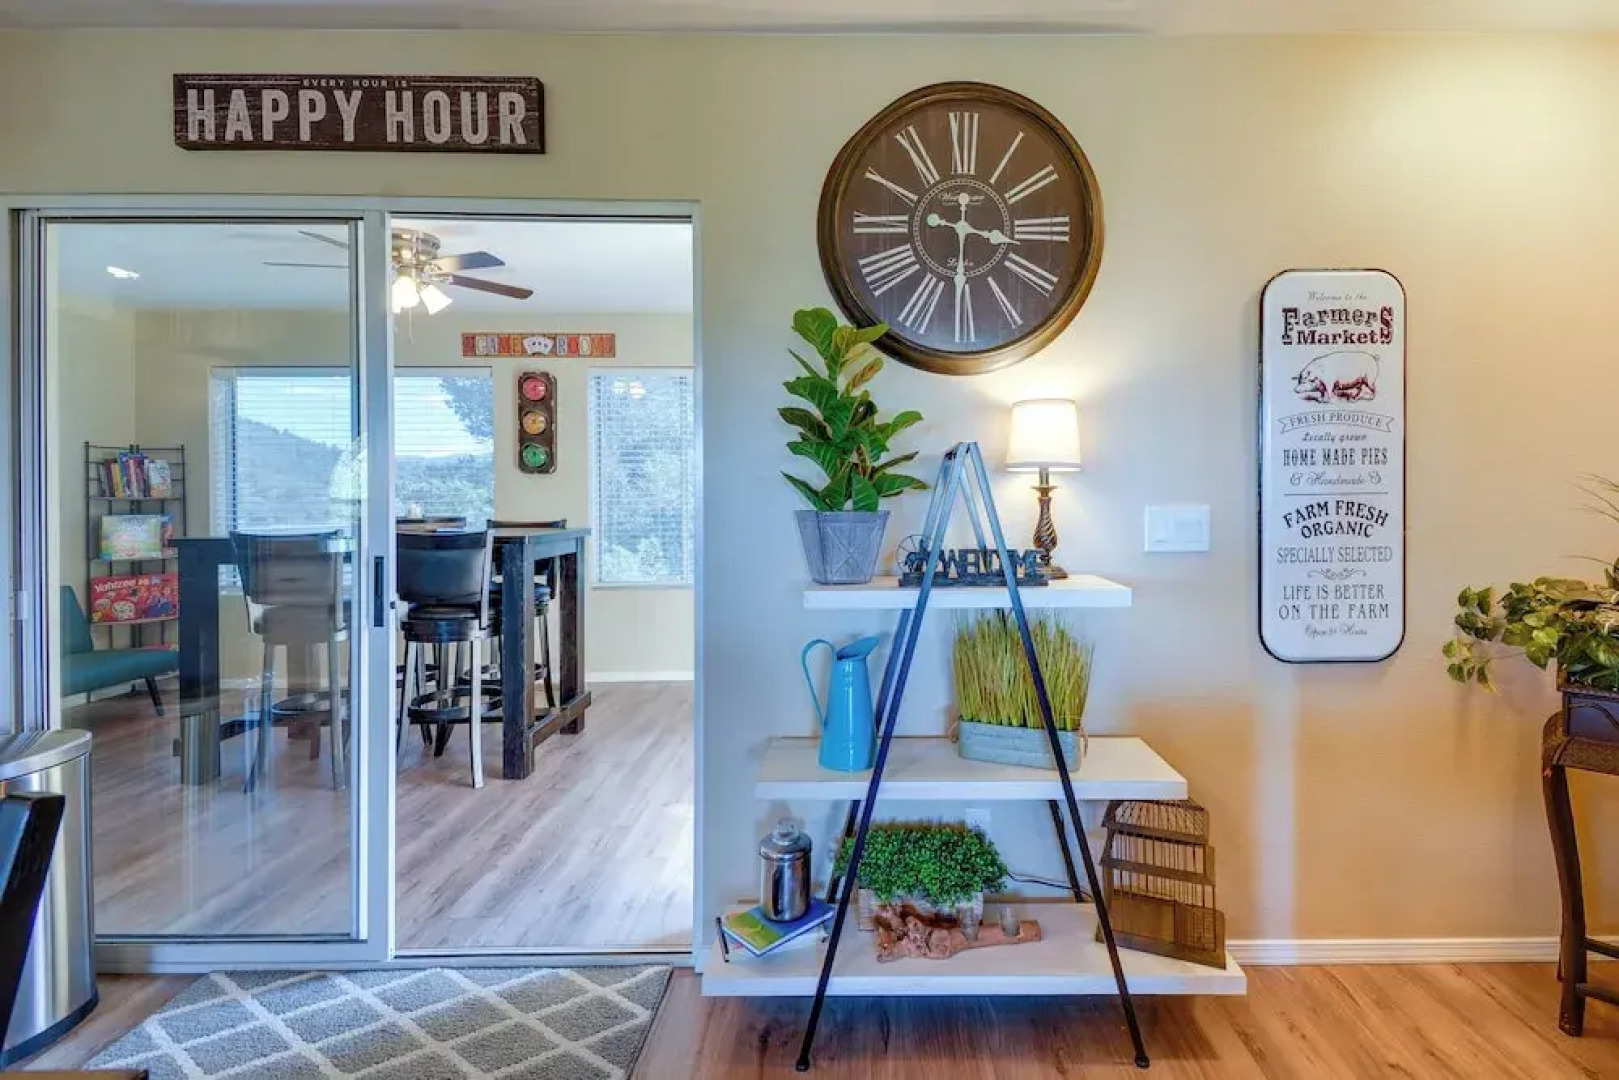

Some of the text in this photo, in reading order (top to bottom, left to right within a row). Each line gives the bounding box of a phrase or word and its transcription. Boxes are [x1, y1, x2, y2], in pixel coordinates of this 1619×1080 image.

[302, 79, 407, 88] EVERY HOUR IS
[186, 88, 527, 145] HAPPY HOUR
[949, 112, 979, 175] XII
[1297, 329, 1379, 345] Market
[1290, 412, 1382, 427] FRESH PRODUCE
[1302, 431, 1367, 443] Locally grown
[1283, 446, 1388, 467] HOME MADE PIES
[1282, 500, 1389, 529] FARM FRESH
[1301, 520, 1375, 539] ORGANIC
[1276, 545, 1393, 564] SPECIALLY SELECTED
[1283, 584, 1385, 600] LIFE IS BETTER
[1278, 603, 1389, 620] ON THE FARM
